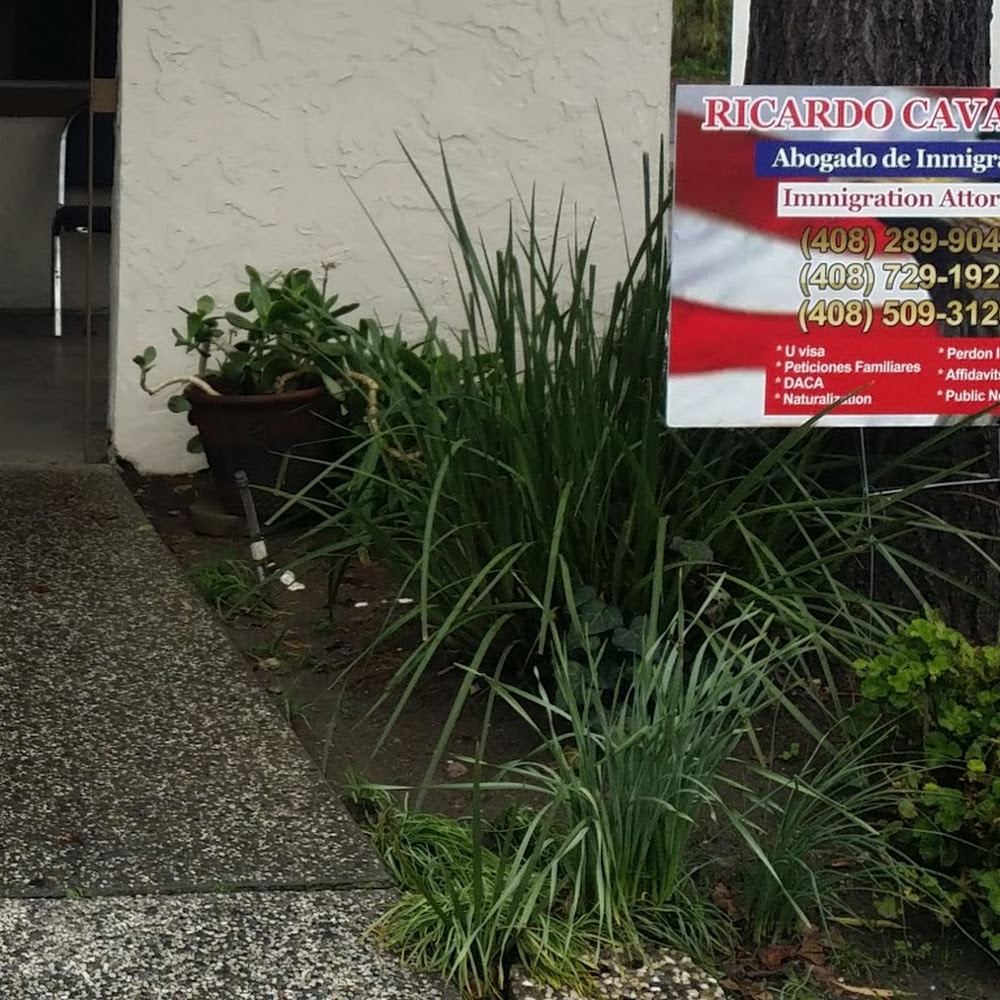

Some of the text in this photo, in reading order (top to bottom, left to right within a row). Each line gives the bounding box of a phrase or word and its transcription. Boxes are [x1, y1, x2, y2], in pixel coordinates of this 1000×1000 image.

[702, 97, 1000, 131] RICARDO CAVA
[771, 146, 1000, 174] Abogado de Inmigr
[783, 187, 1000, 212] Immigration Attor
[801, 226, 1000, 260] (408) 289-904
[799, 262, 1000, 297] (408) 729-192
[797, 299, 1000, 333] (408) 509-312
[785, 345, 826, 357] U visa
[947, 347, 993, 360] Perdon
[784, 361, 922, 373] Peticiones Familiares
[783, 377, 825, 389] DACA
[945, 389, 986, 402] Public
